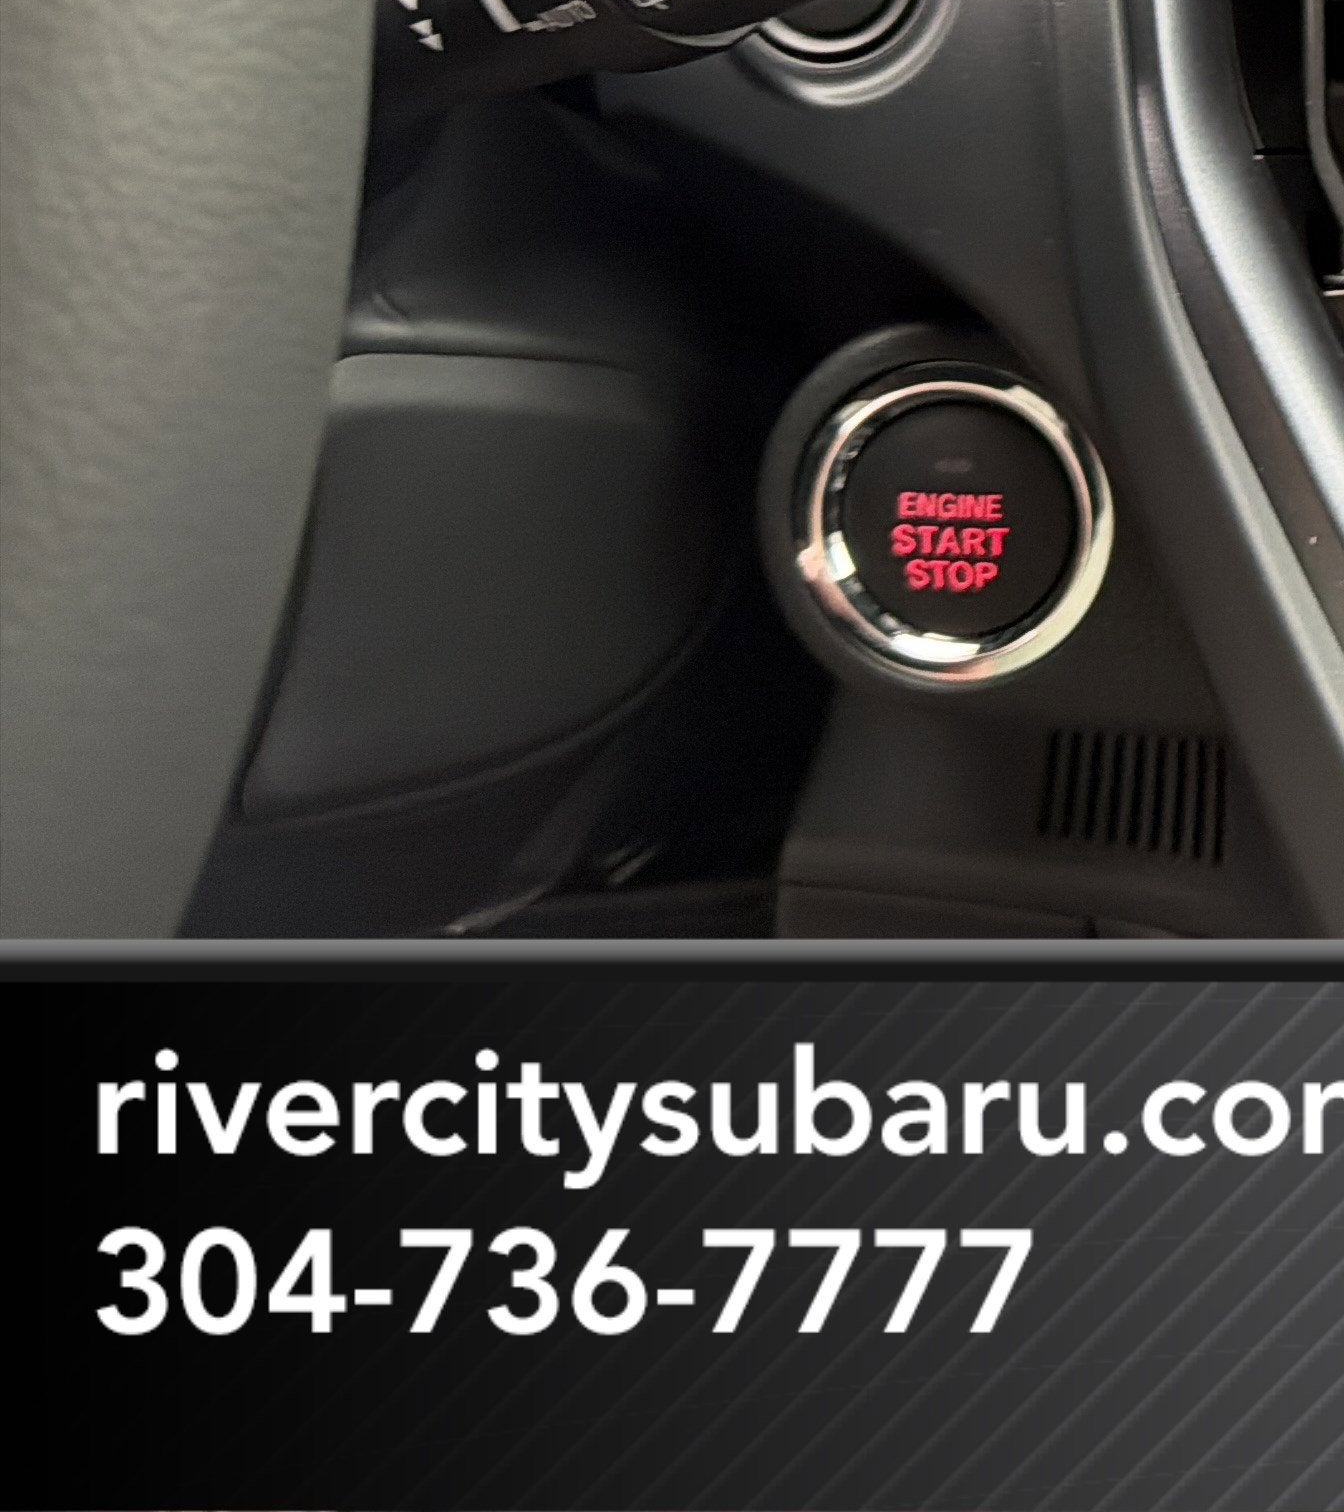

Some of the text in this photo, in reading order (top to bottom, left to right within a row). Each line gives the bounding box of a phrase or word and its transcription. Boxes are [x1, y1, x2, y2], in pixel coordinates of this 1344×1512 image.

[897, 491, 1003, 521] ENGINE
[891, 524, 1009, 557] START
[905, 560, 999, 592] STOP
